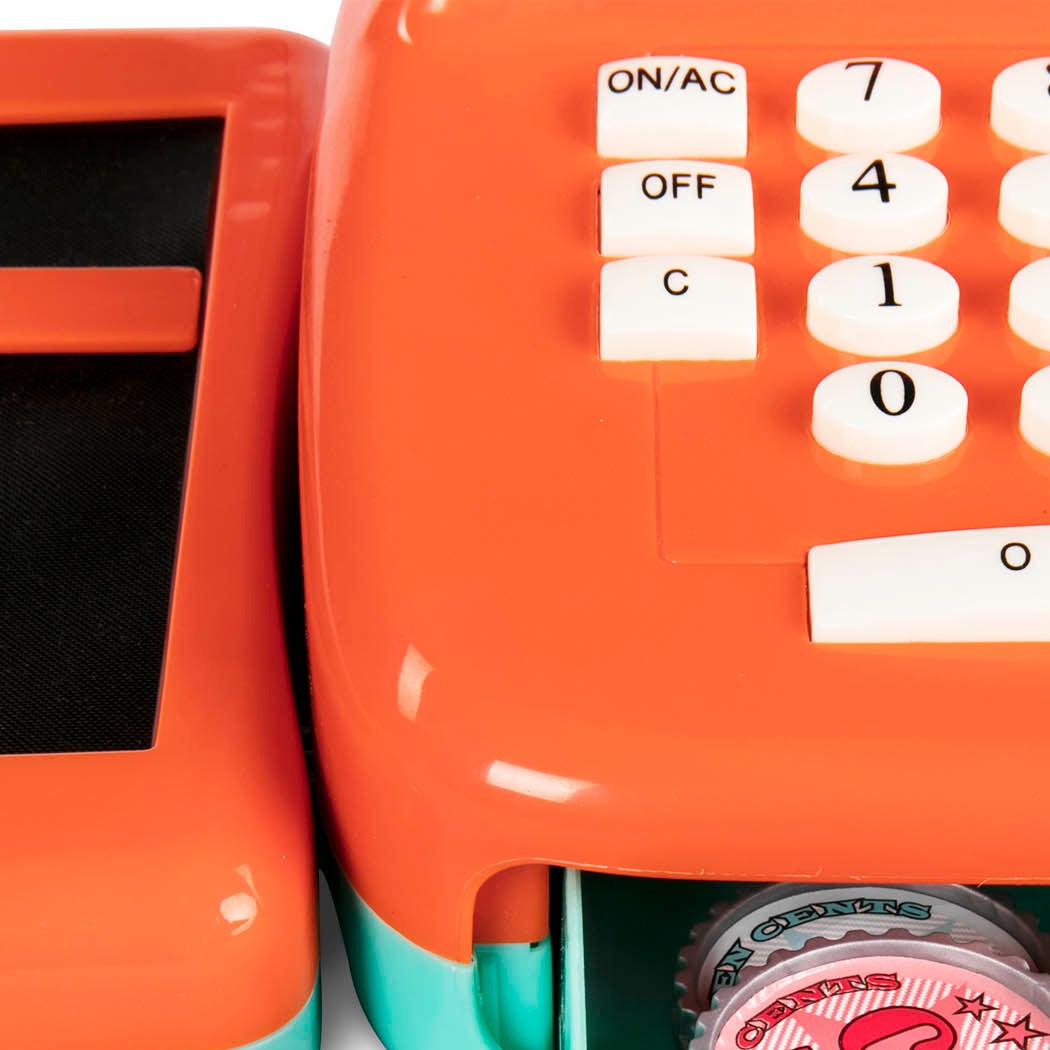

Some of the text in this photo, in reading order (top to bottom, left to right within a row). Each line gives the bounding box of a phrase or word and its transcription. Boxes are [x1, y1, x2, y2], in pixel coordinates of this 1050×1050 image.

[607, 66, 736, 96] ON/AC
[845, 61, 884, 102] 7
[641, 173, 717, 200] OFF
[851, 159, 898, 204] 4
[662, 269, 690, 297] C
[873, 262, 902, 308] 1
[868, 368, 917, 418] 0
[751, 897, 932, 943] CENTS
[735, 972, 901, 1050] CENTS
